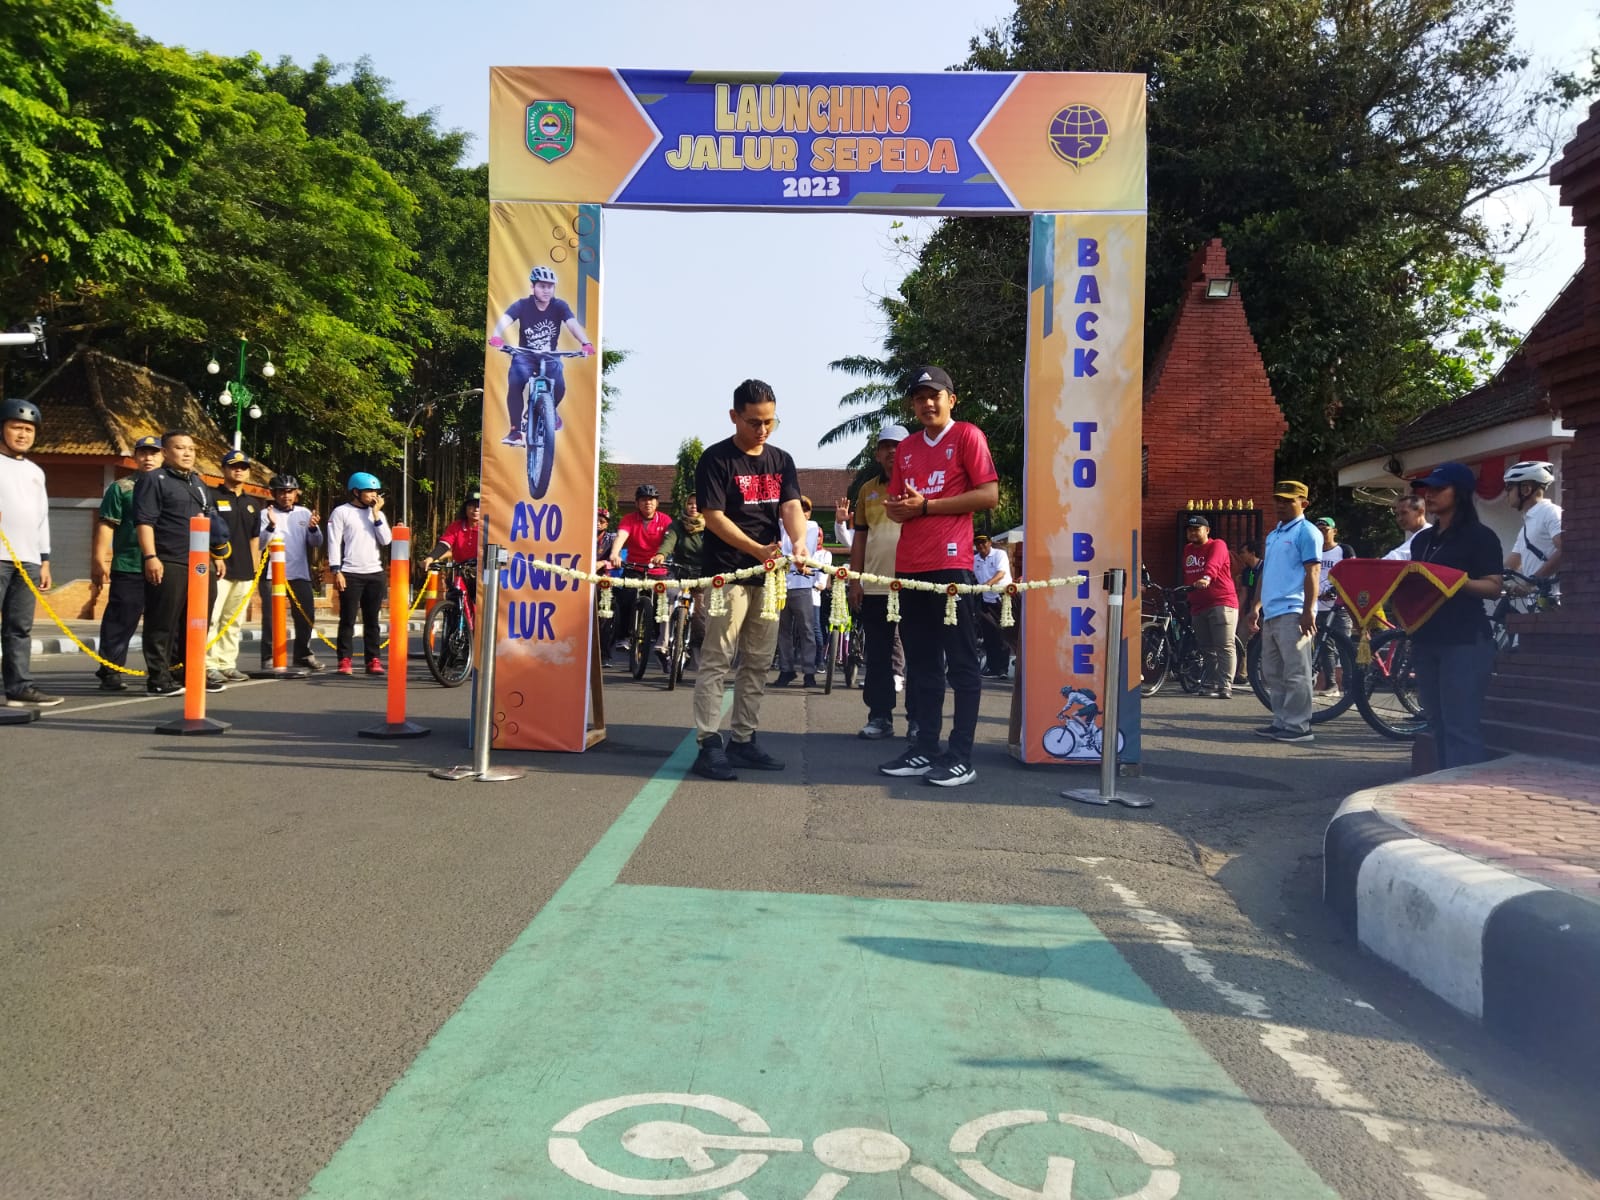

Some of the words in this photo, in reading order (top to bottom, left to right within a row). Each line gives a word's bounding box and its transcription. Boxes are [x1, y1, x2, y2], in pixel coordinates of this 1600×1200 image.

[715, 83, 911, 134] LAUNCHING
[665, 135, 799, 171] JALUR
[810, 137, 959, 173] SEPEDA
[782, 177, 841, 197] 2023
[1073, 237, 1102, 378] BACK
[1072, 421, 1098, 488] TO
[510, 501, 563, 542] AYO
[508, 600, 556, 640] LUR
[1071, 532, 1097, 674] BIKE
